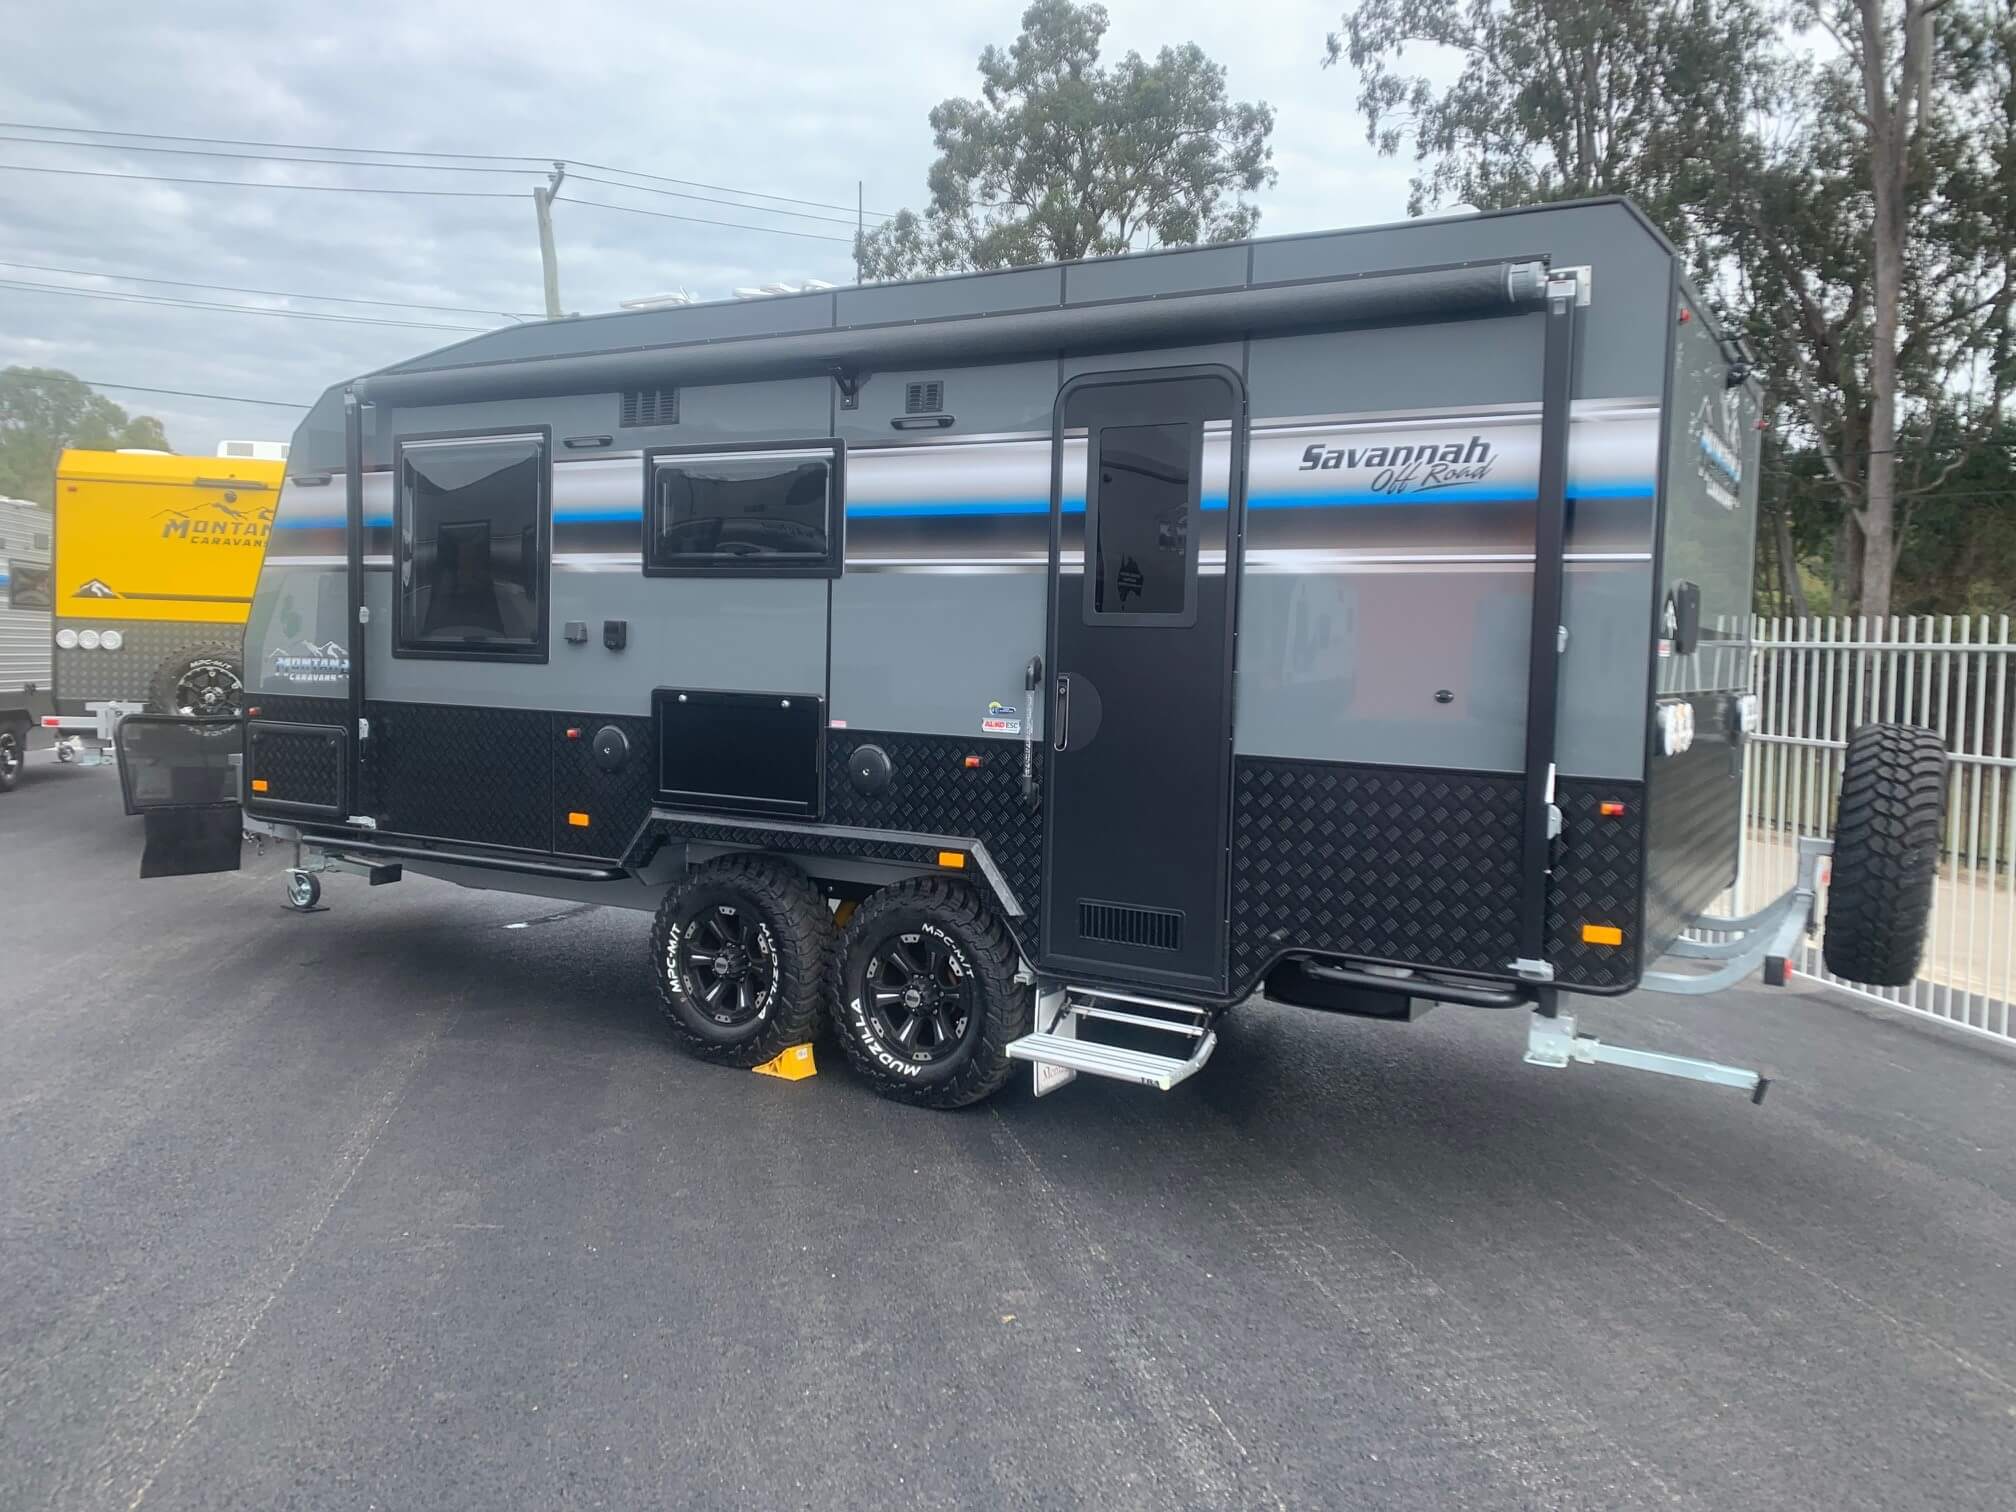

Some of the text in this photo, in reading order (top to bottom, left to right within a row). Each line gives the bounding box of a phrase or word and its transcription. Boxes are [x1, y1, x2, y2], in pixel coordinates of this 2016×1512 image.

[1299, 436, 1492, 471] Savannah
[1371, 454, 1499, 495] Off Road
[162, 518, 271, 539] MONTAN
[666, 922, 683, 993] MPC-M/T
[758, 922, 779, 1020] MUDZILLA
[921, 922, 975, 979] MPC-M/T
[850, 998, 921, 1077] MUDZILLA
